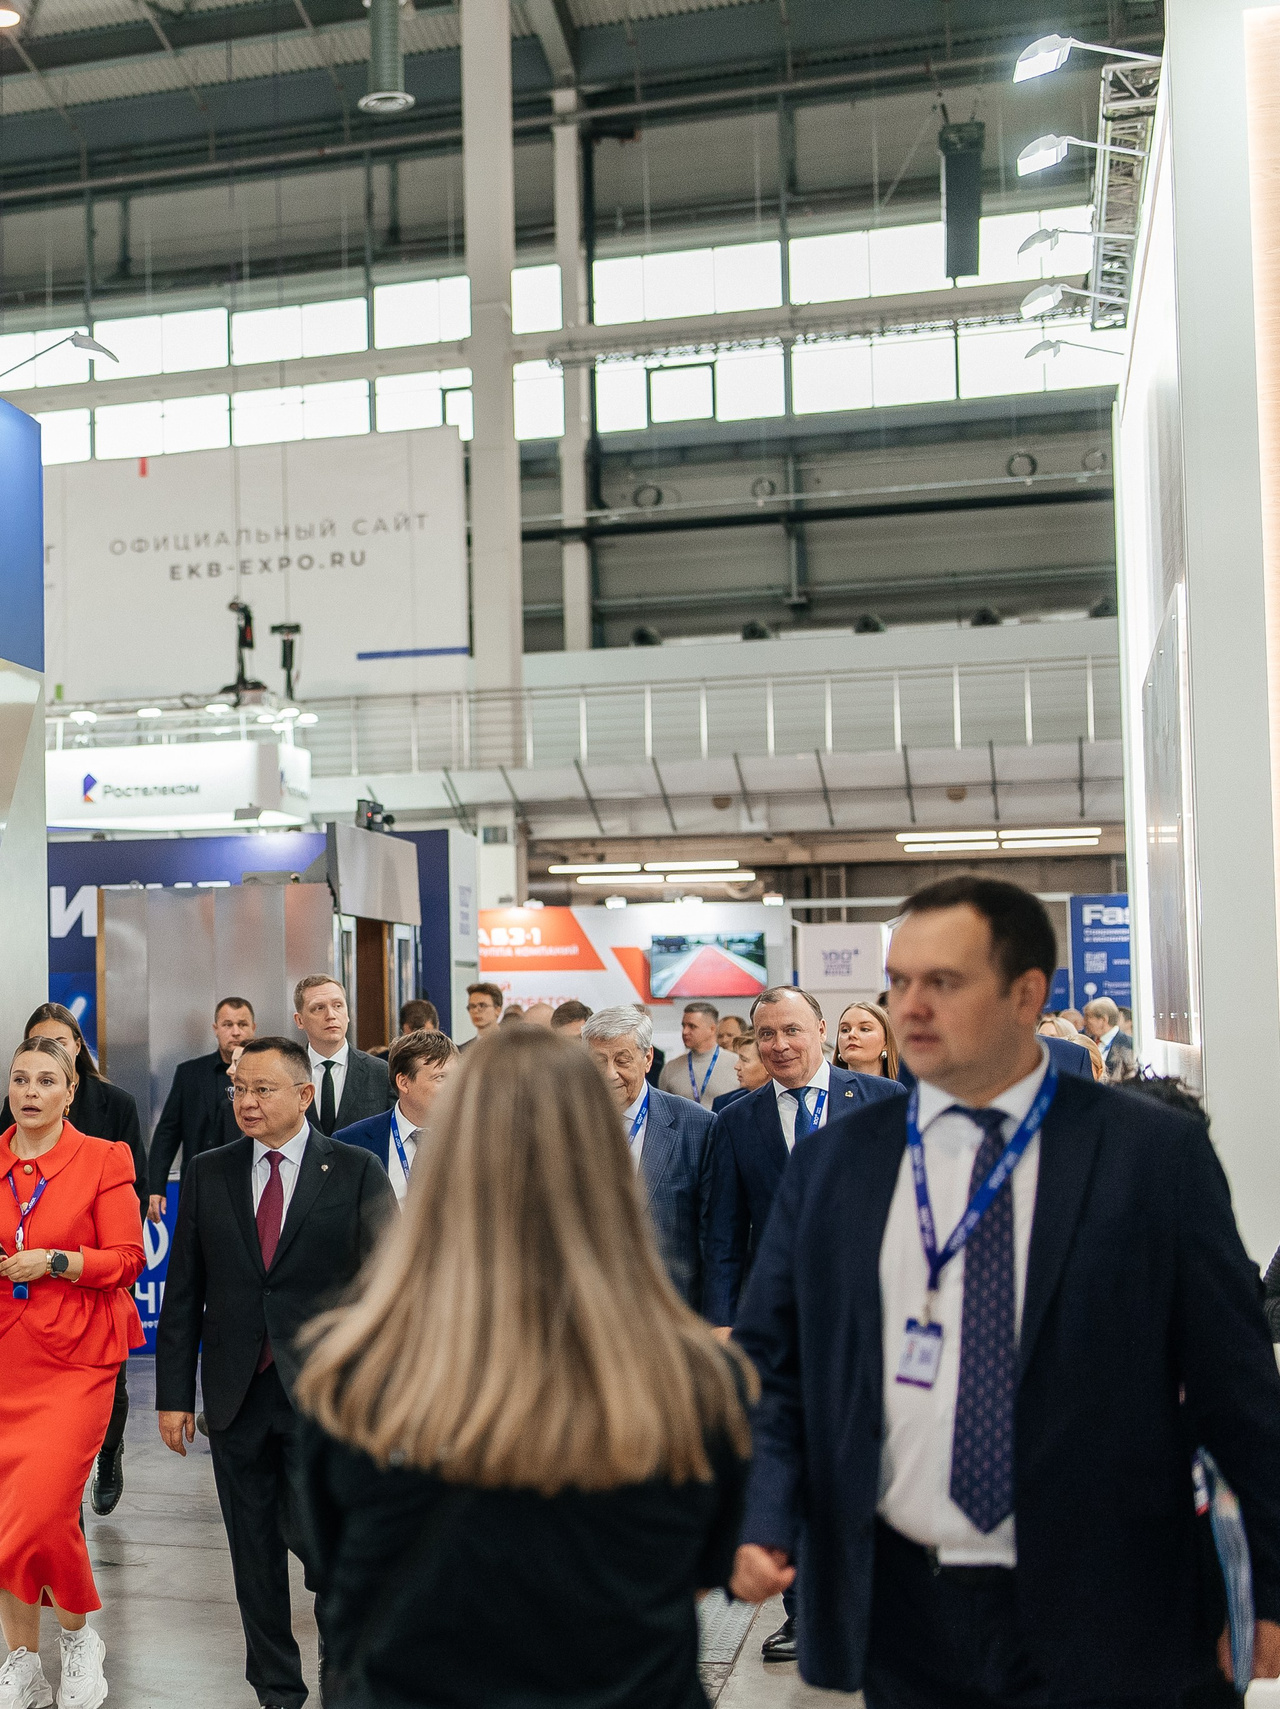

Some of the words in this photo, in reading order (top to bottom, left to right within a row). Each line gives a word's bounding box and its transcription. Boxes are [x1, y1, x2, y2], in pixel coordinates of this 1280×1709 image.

[109, 517, 337, 557] ОФИЦИАЛЬНЫЙ
[351, 512, 429, 538] САЙТ
[169, 551, 367, 581] EKB-EXPO.RU
[103, 784, 201, 798] Ростелеком
